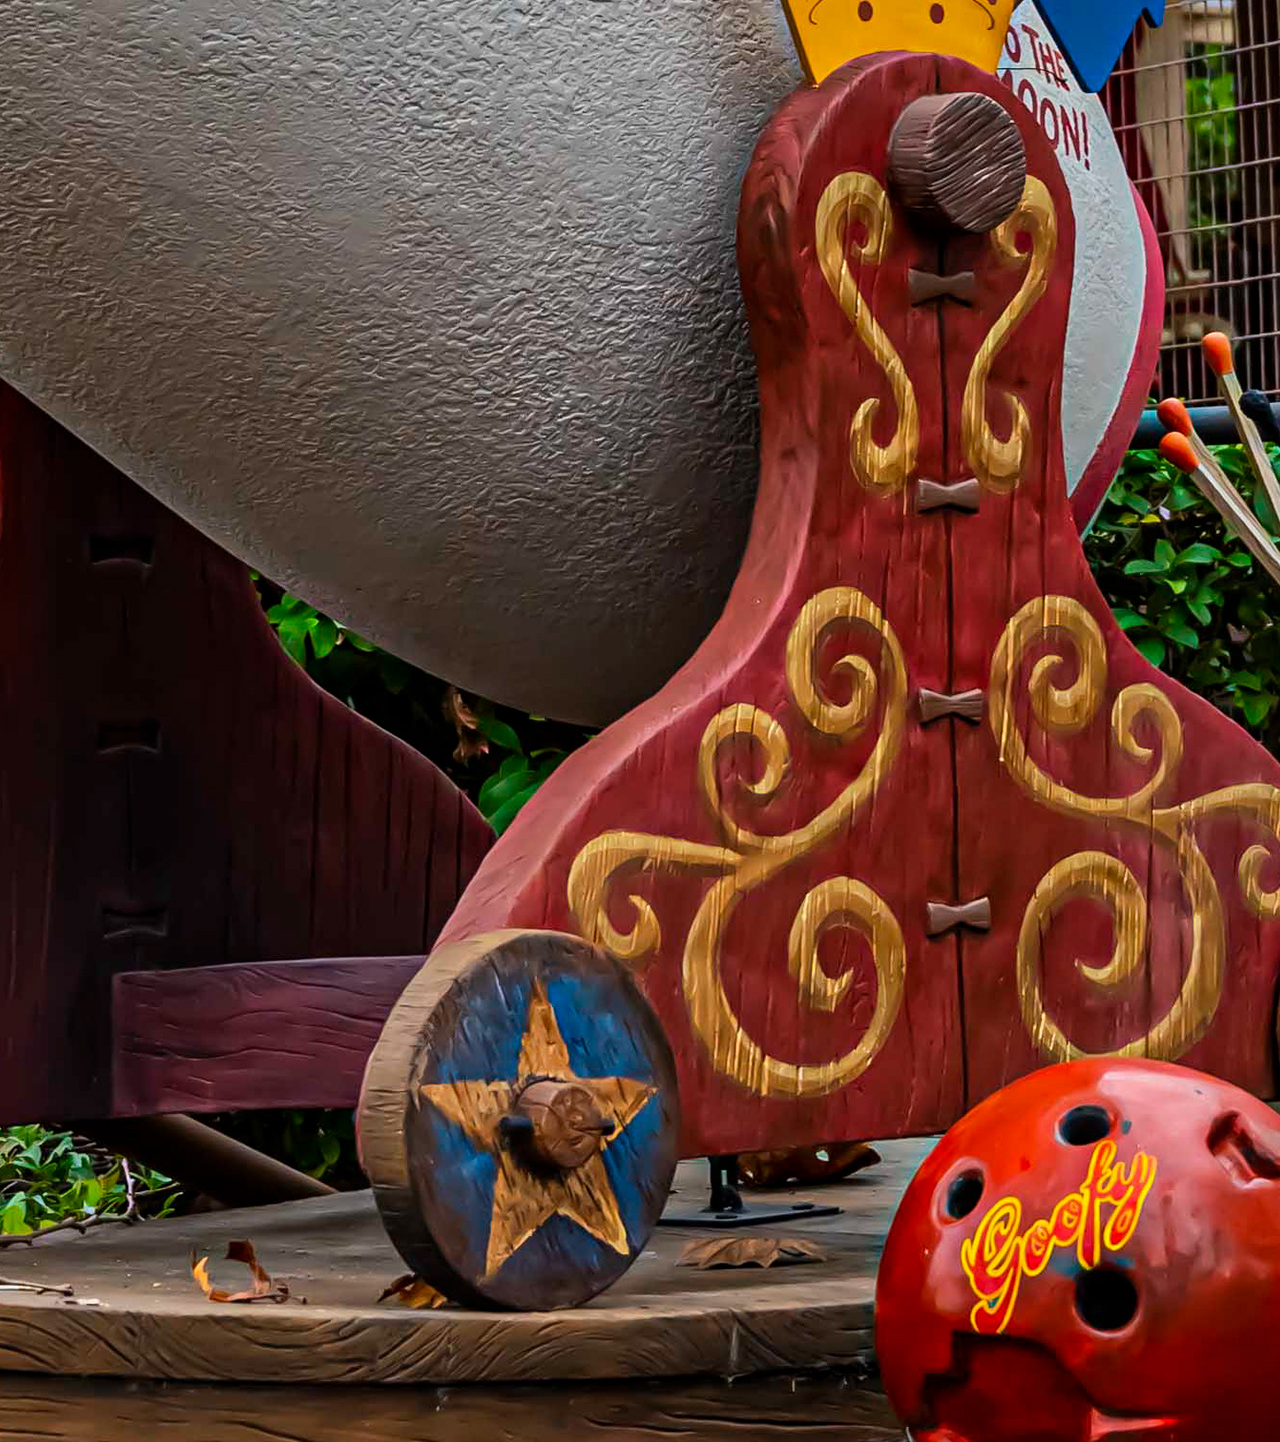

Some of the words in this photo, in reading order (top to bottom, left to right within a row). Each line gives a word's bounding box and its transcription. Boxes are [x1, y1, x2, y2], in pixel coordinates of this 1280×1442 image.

[1021, 23, 1070, 91] THE
[998, 69, 1090, 171] OON!
[961, 1139, 1157, 1335] Goofy
